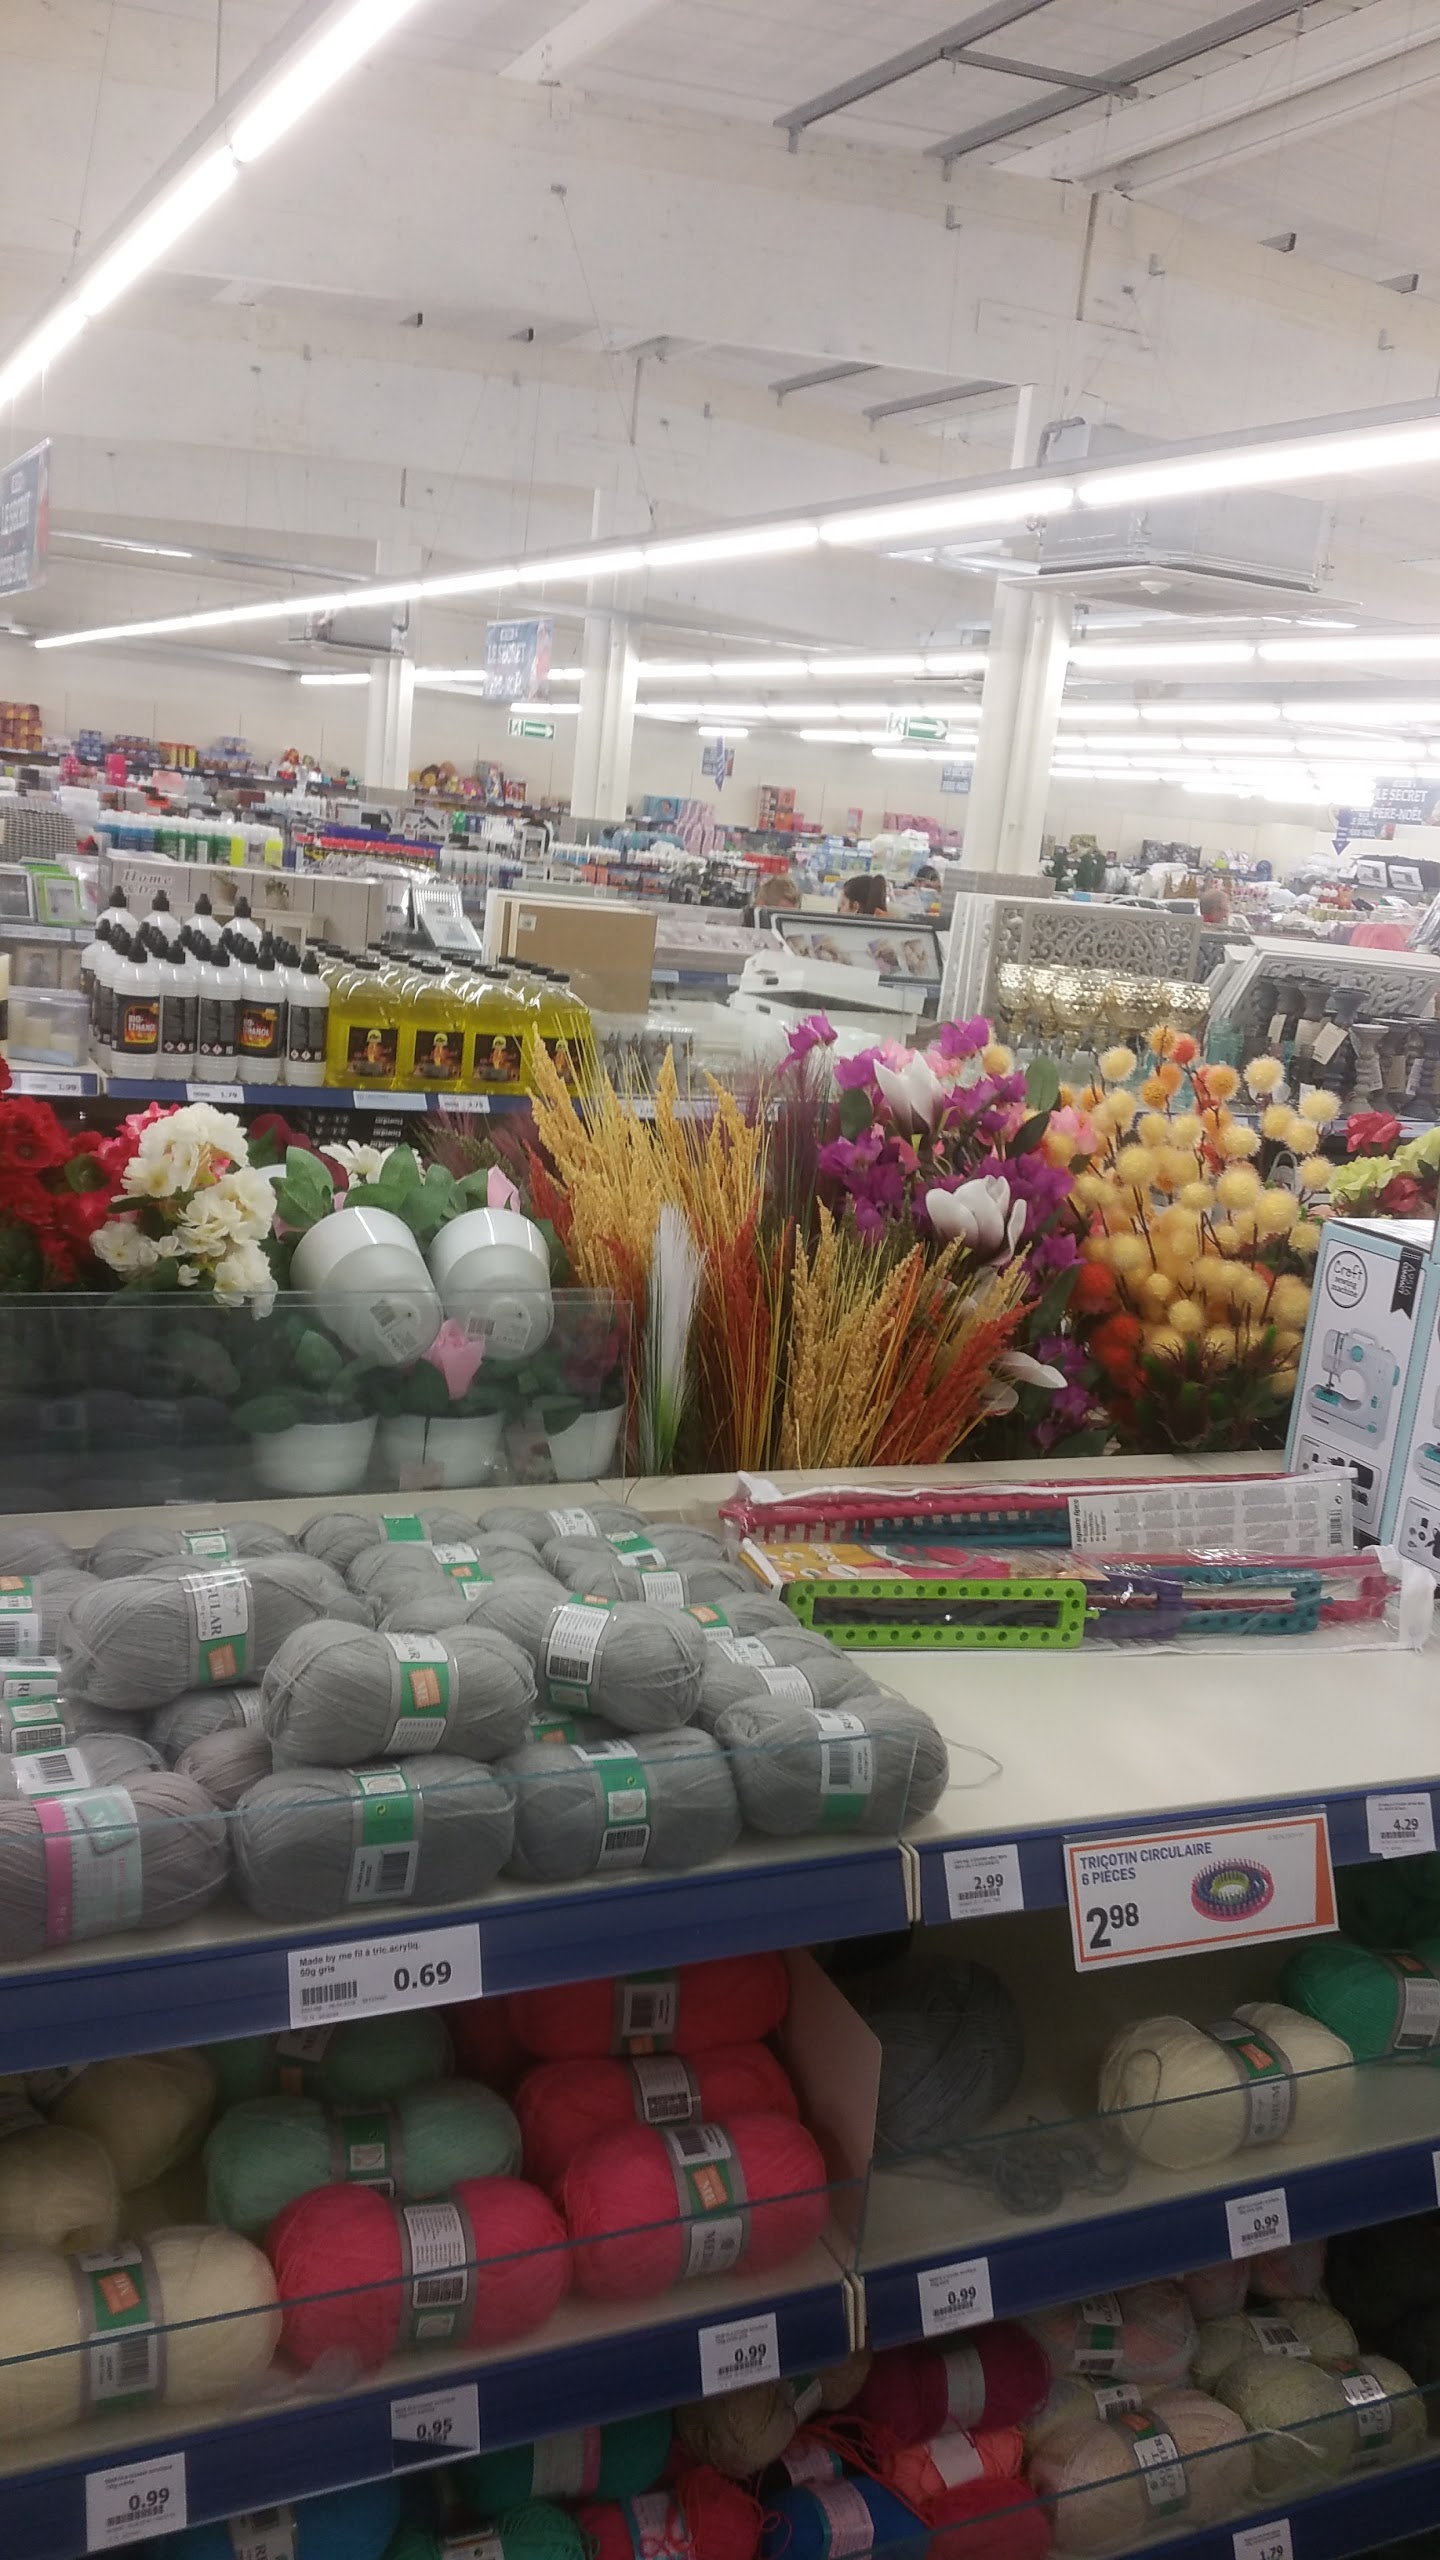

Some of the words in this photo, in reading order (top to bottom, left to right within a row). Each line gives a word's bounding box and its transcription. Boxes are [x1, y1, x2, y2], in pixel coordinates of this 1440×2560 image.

[1376, 788, 1388, 800] LE
[1389, 788, 1429, 803] SECRET
[123, 869, 173, 885] Home
[1333, 1260, 1363, 1281] Craft
[1393, 1818, 1419, 1831] 4.29
[1080, 1850, 1138, 1871] TRICOTIN
[1140, 1842, 1213, 1863] CIRCULAIRE
[973, 1873, 1004, 1890] 2.99
[1081, 1873, 1090, 1886] 6
[1092, 1865, 1137, 1885] PIÈCES
[300, 1957, 323, 1967] Made
[326, 1954, 336, 1964] by
[338, 1952, 353, 1960] me
[354, 1949, 363, 1958] fil
[300, 1967, 316, 1977] 50g
[319, 1965, 335, 1975] gris
[393, 1961, 452, 1992] 0.69
[1254, 2214, 1279, 2231] 0.99
[948, 2286, 976, 2304] 0.99
[735, 2343, 767, 2362] 0.99
[416, 2418, 453, 2440] 0.95
[128, 2488, 170, 2511] 0.99
